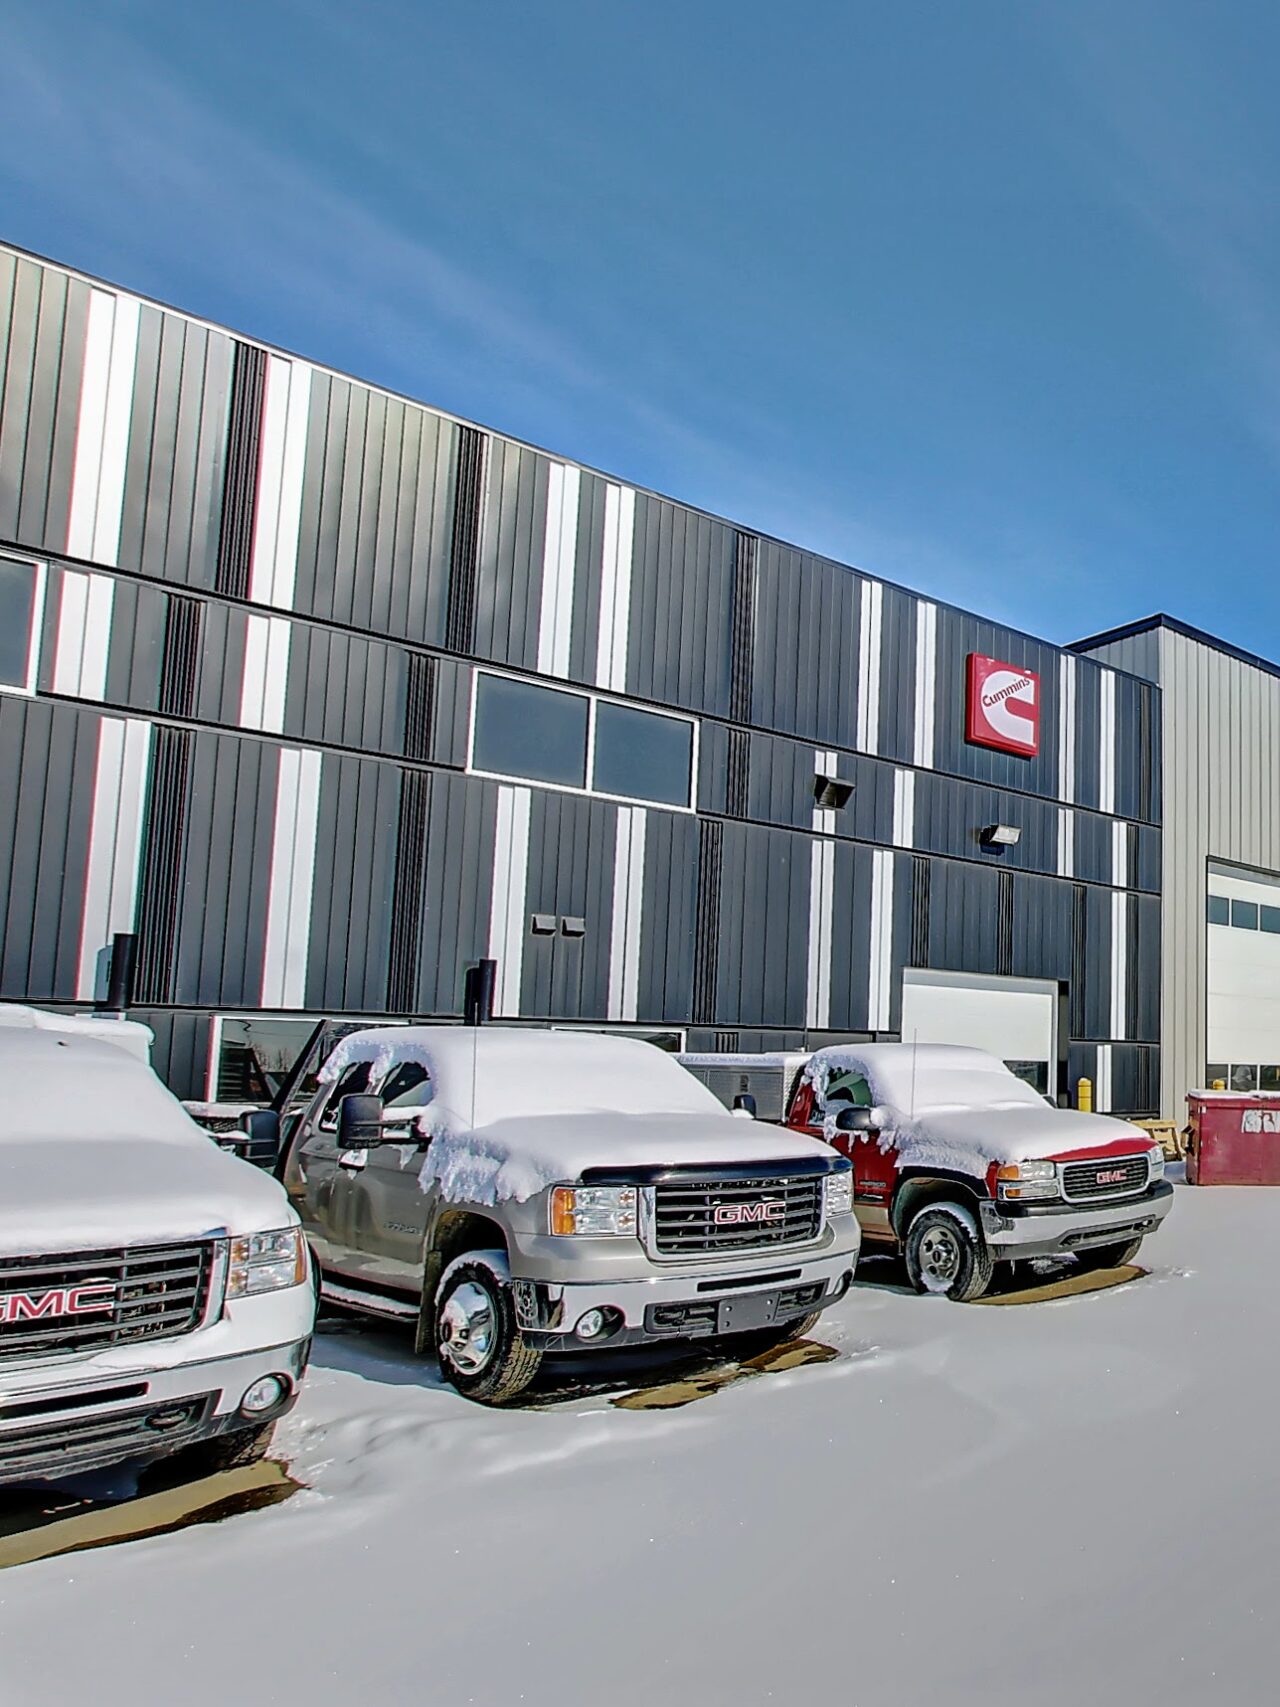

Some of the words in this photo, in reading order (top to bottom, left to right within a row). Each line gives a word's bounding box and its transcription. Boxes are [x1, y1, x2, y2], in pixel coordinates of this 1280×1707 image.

[982, 678, 1031, 707] Cummins
[1096, 1169, 1127, 1184] GMC
[714, 1202, 786, 1225] GMC
[0, 1284, 116, 1323] MC
